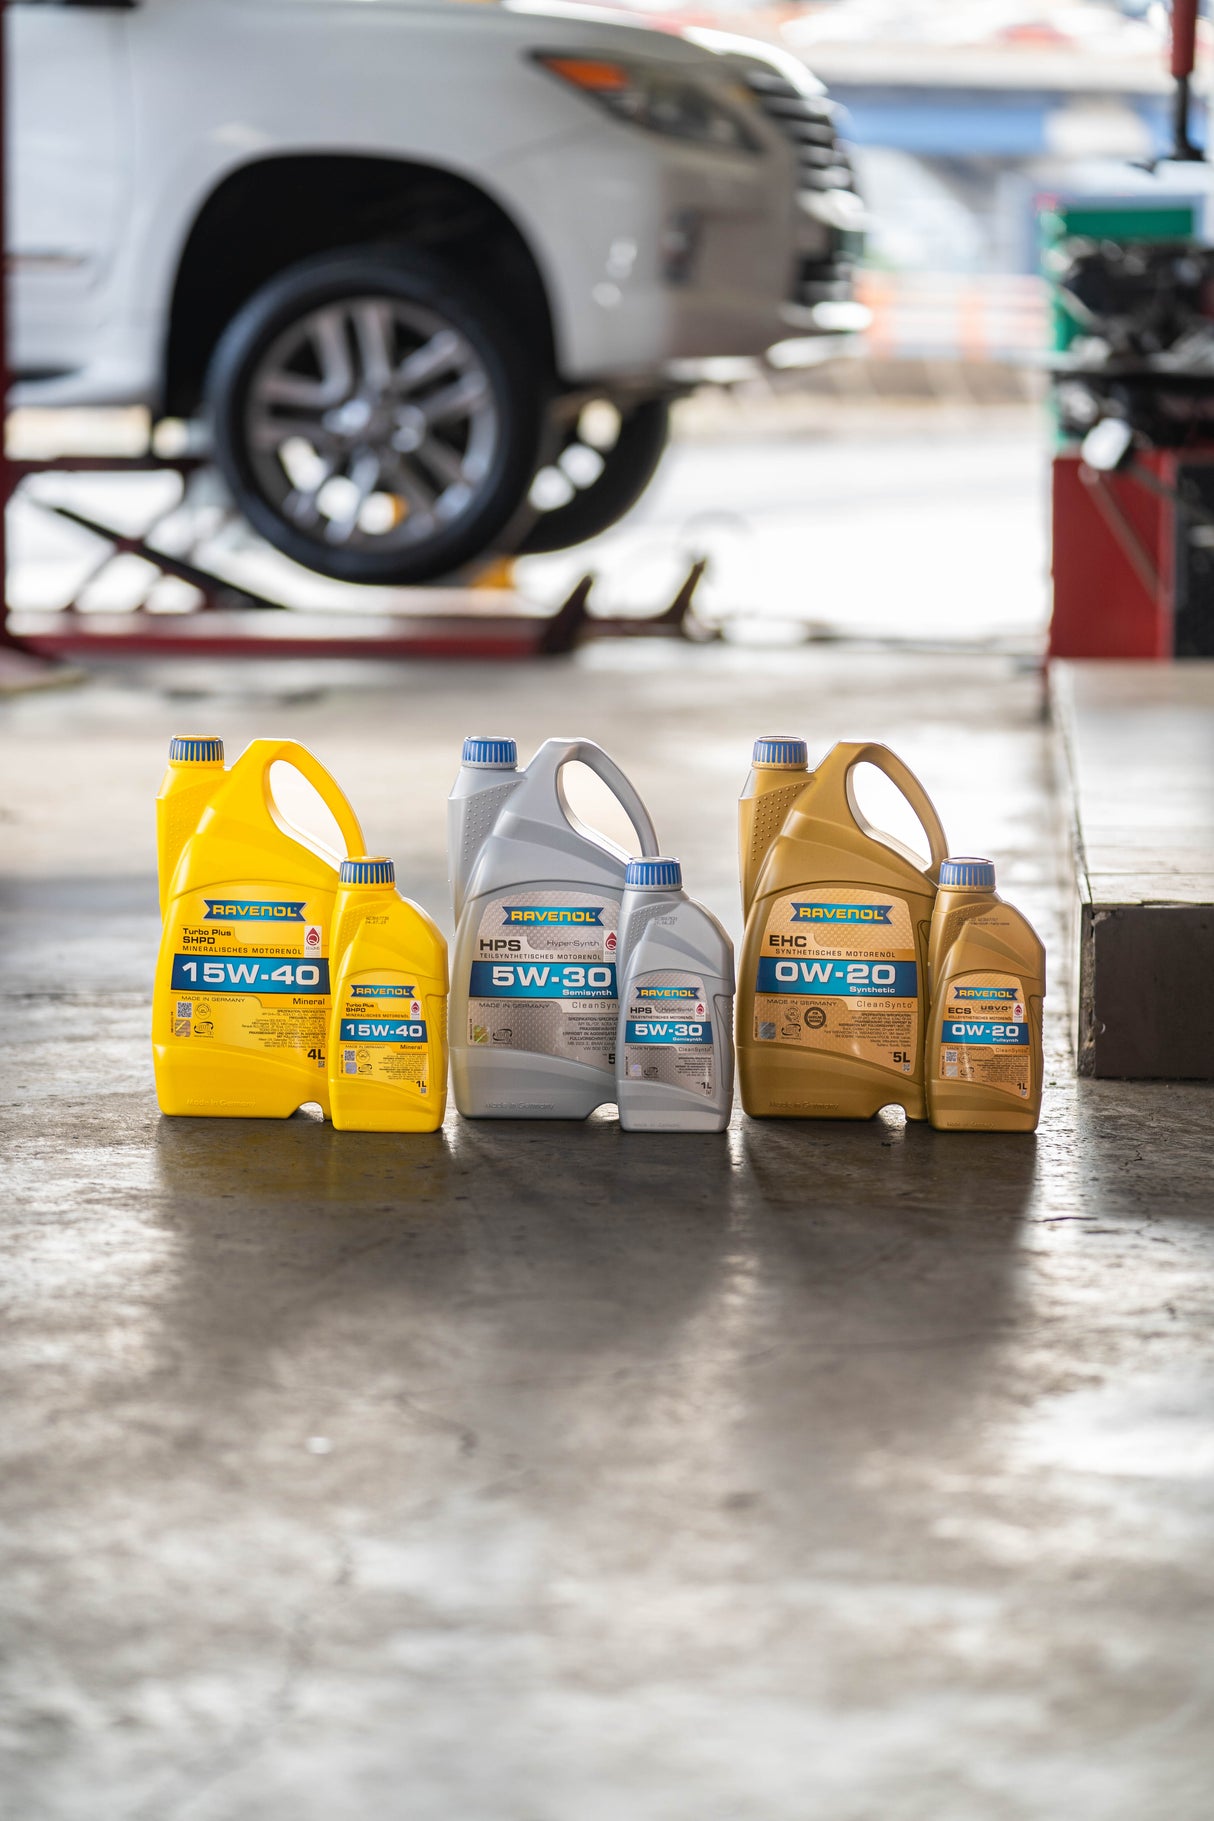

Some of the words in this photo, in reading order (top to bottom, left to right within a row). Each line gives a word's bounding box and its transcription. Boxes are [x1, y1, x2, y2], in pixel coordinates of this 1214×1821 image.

[212, 904, 297, 917] RAVENOL
[800, 907, 883, 920] RAVENOL
[511, 911, 595, 922] RAVENOL
[182, 936, 215, 944] SHPD
[480, 939, 521, 951] HPS
[769, 935, 807, 947] EHC
[182, 945, 248, 953] MINERALISCHES
[182, 962, 320, 986] 15W-40
[492, 966, 612, 987] 5W-30
[775, 961, 896, 985] 0W-20
[355, 988, 410, 996] RAVENOL
[562, 989, 612, 997] Semisynth
[640, 989, 695, 997] RAVENOL
[849, 986, 896, 994] Synthetic
[959, 990, 1012, 998] RAVENOL
[346, 1024, 422, 1037] 15W-40
[635, 1024, 702, 1036] 5W-30
[951, 1024, 1019, 1037] 0W-20
[307, 1049, 325, 1060] 4L
[893, 1052, 911, 1063] 5L
[416, 1080, 427, 1088] 1L
